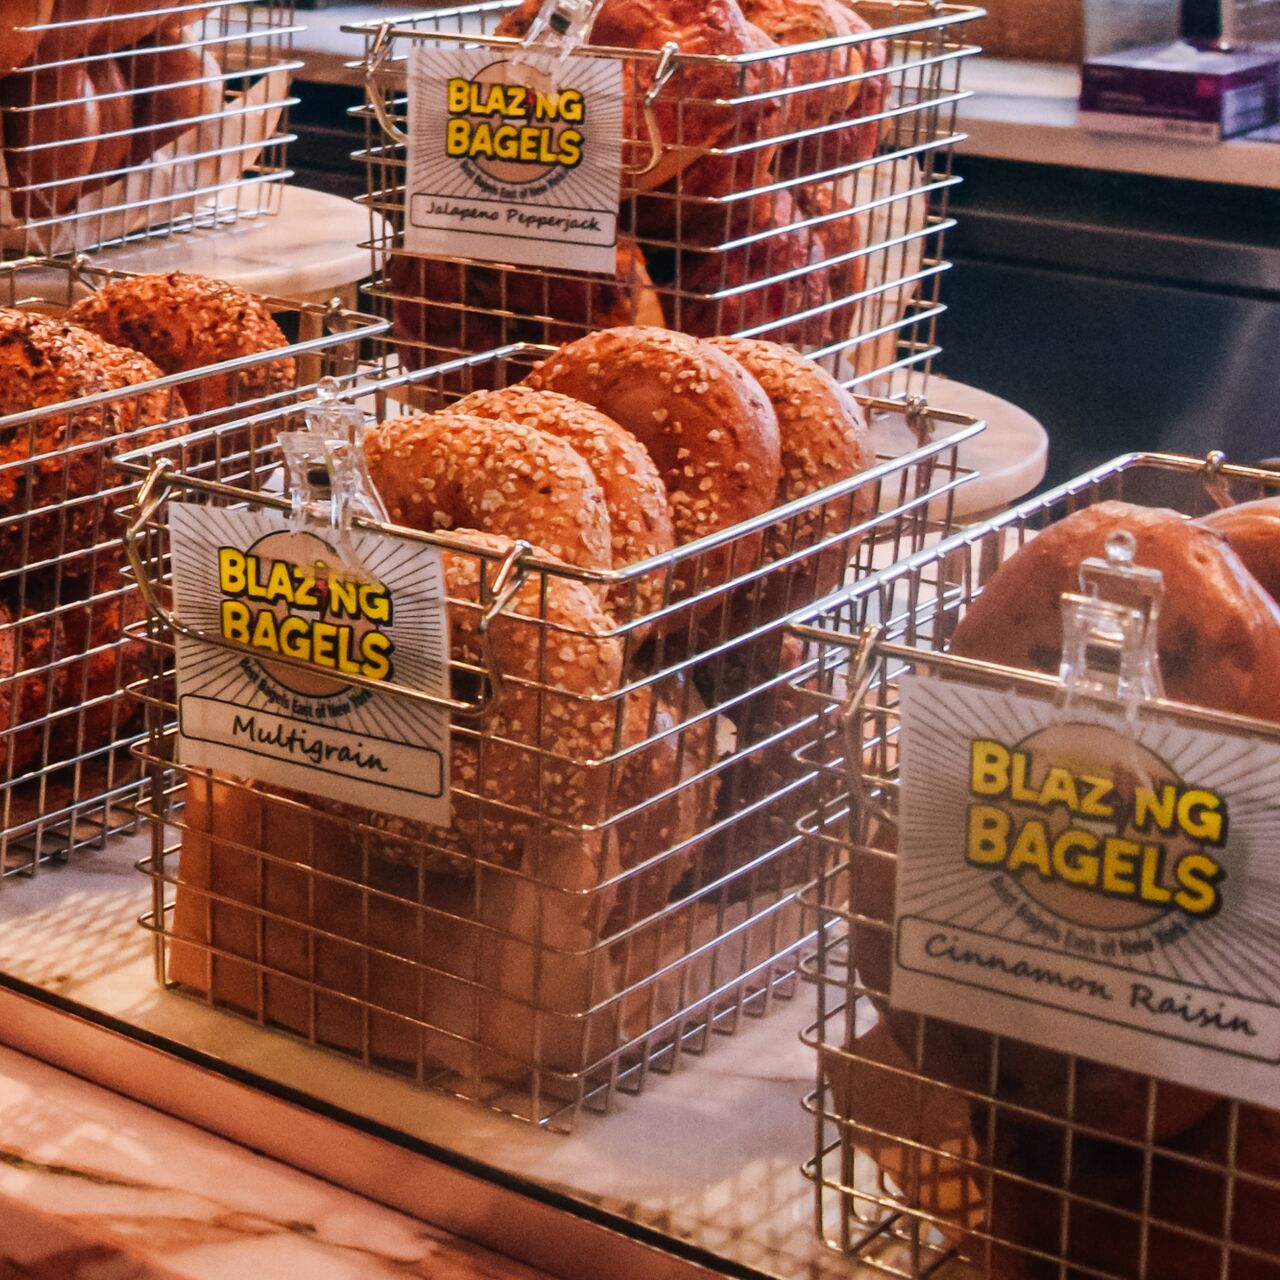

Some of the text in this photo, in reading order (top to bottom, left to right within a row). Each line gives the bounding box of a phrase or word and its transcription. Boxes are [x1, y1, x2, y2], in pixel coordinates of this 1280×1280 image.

[446, 117, 584, 167] BAGELS
[506, 209, 602, 232] Pepperjack
[219, 598, 395, 682] BAGELS
[232, 715, 388, 772] Multigrain
[964, 803, 1224, 919] BAGELS
[924, 932, 1258, 1037] Cinnamon Raisin
